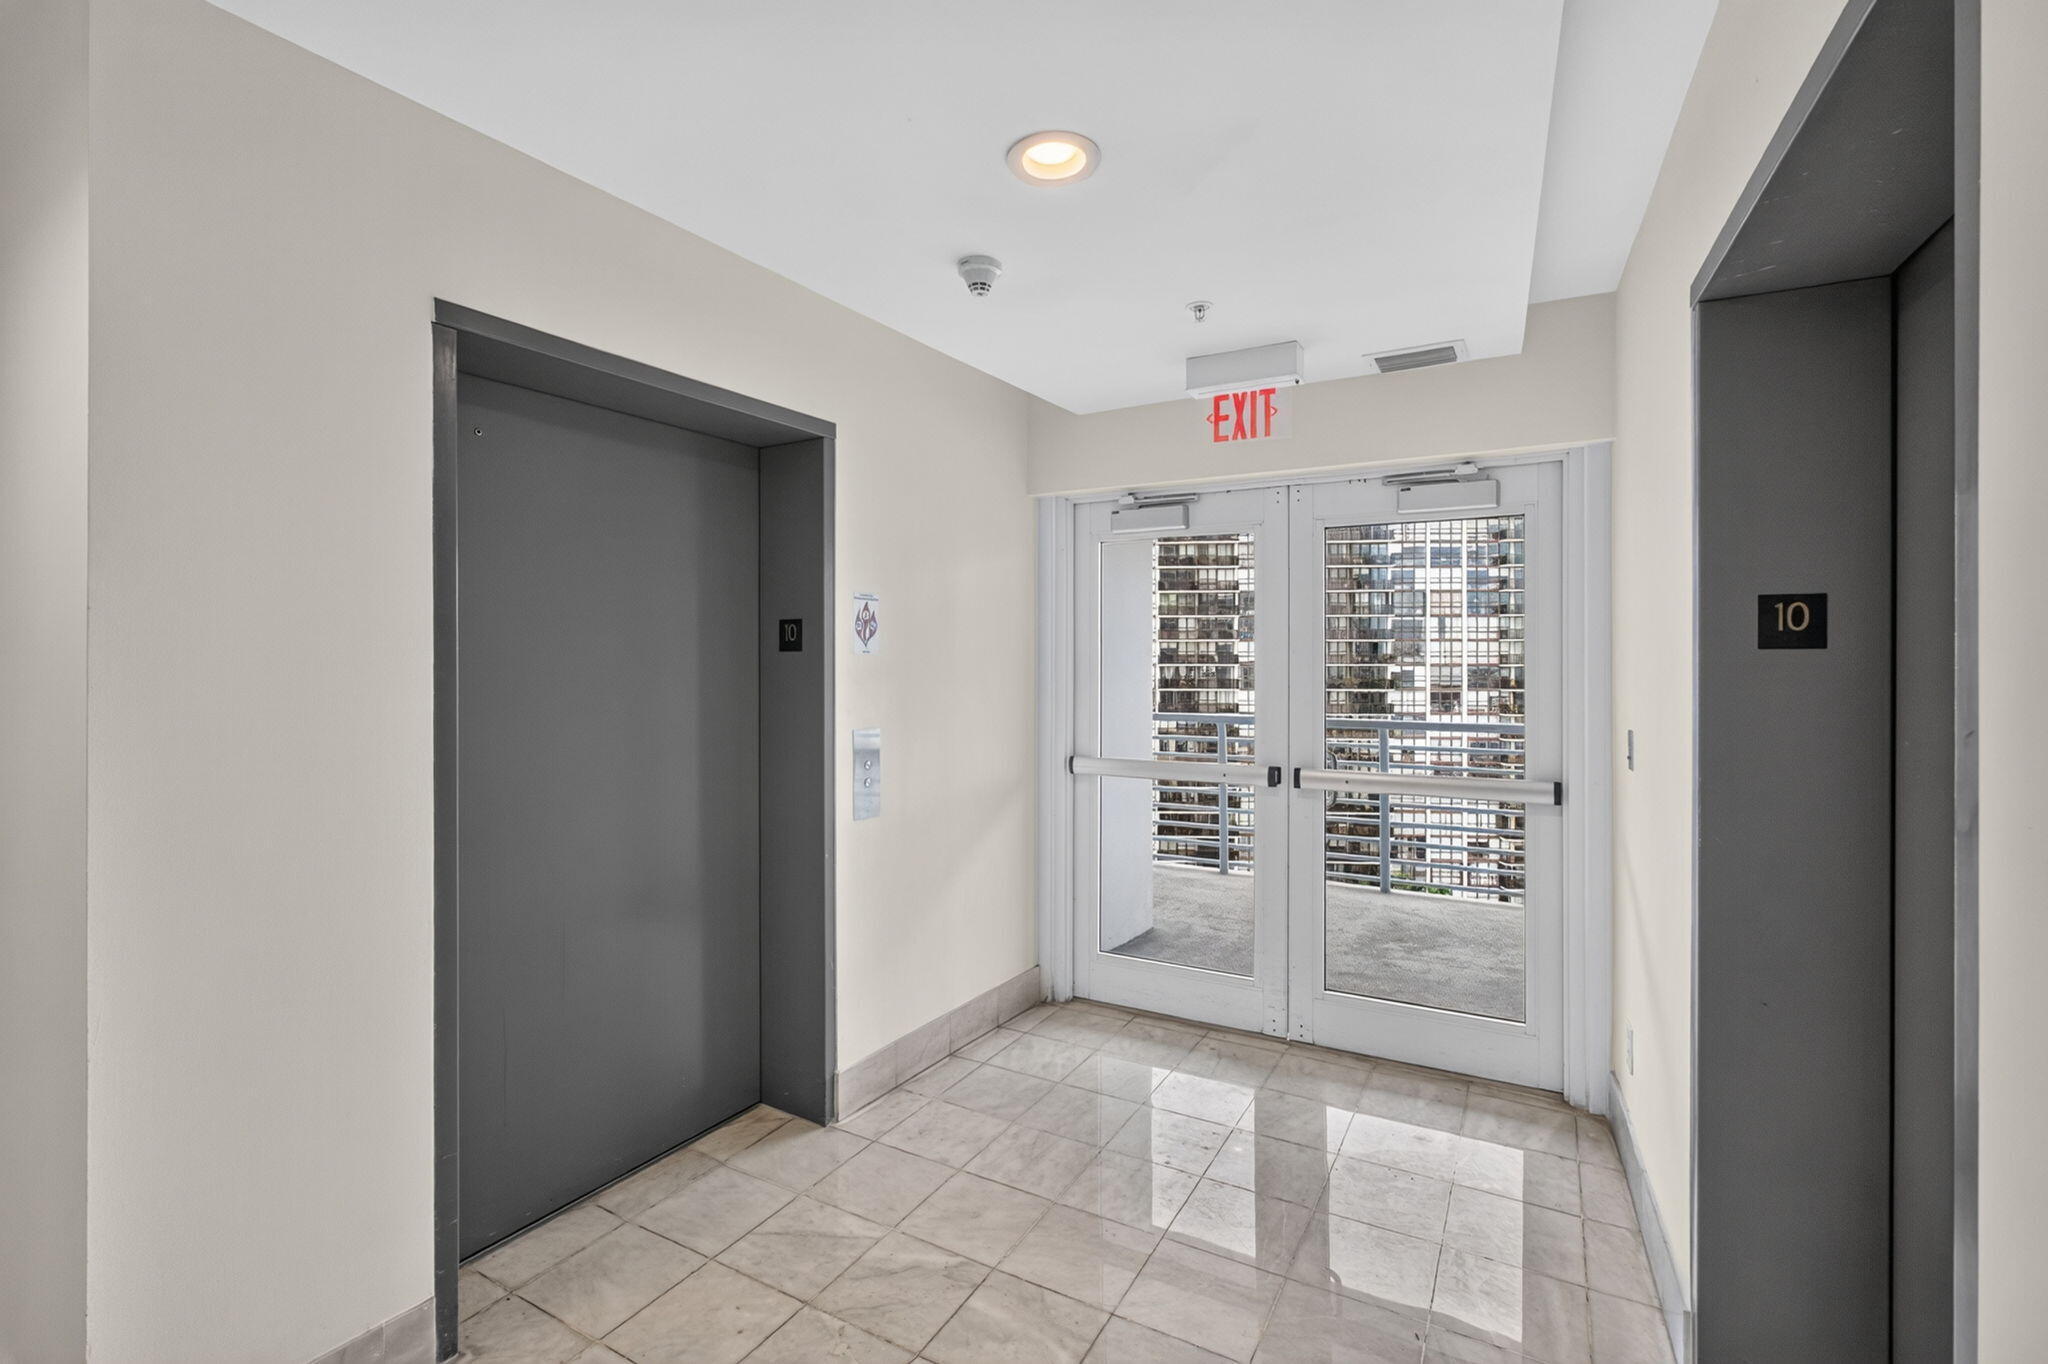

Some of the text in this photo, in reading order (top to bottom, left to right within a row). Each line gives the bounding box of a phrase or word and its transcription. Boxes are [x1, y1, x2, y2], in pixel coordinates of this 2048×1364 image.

[1213, 388, 1276, 443] EXIT
[1774, 601, 1810, 632] 10
[784, 623, 797, 642] 10
